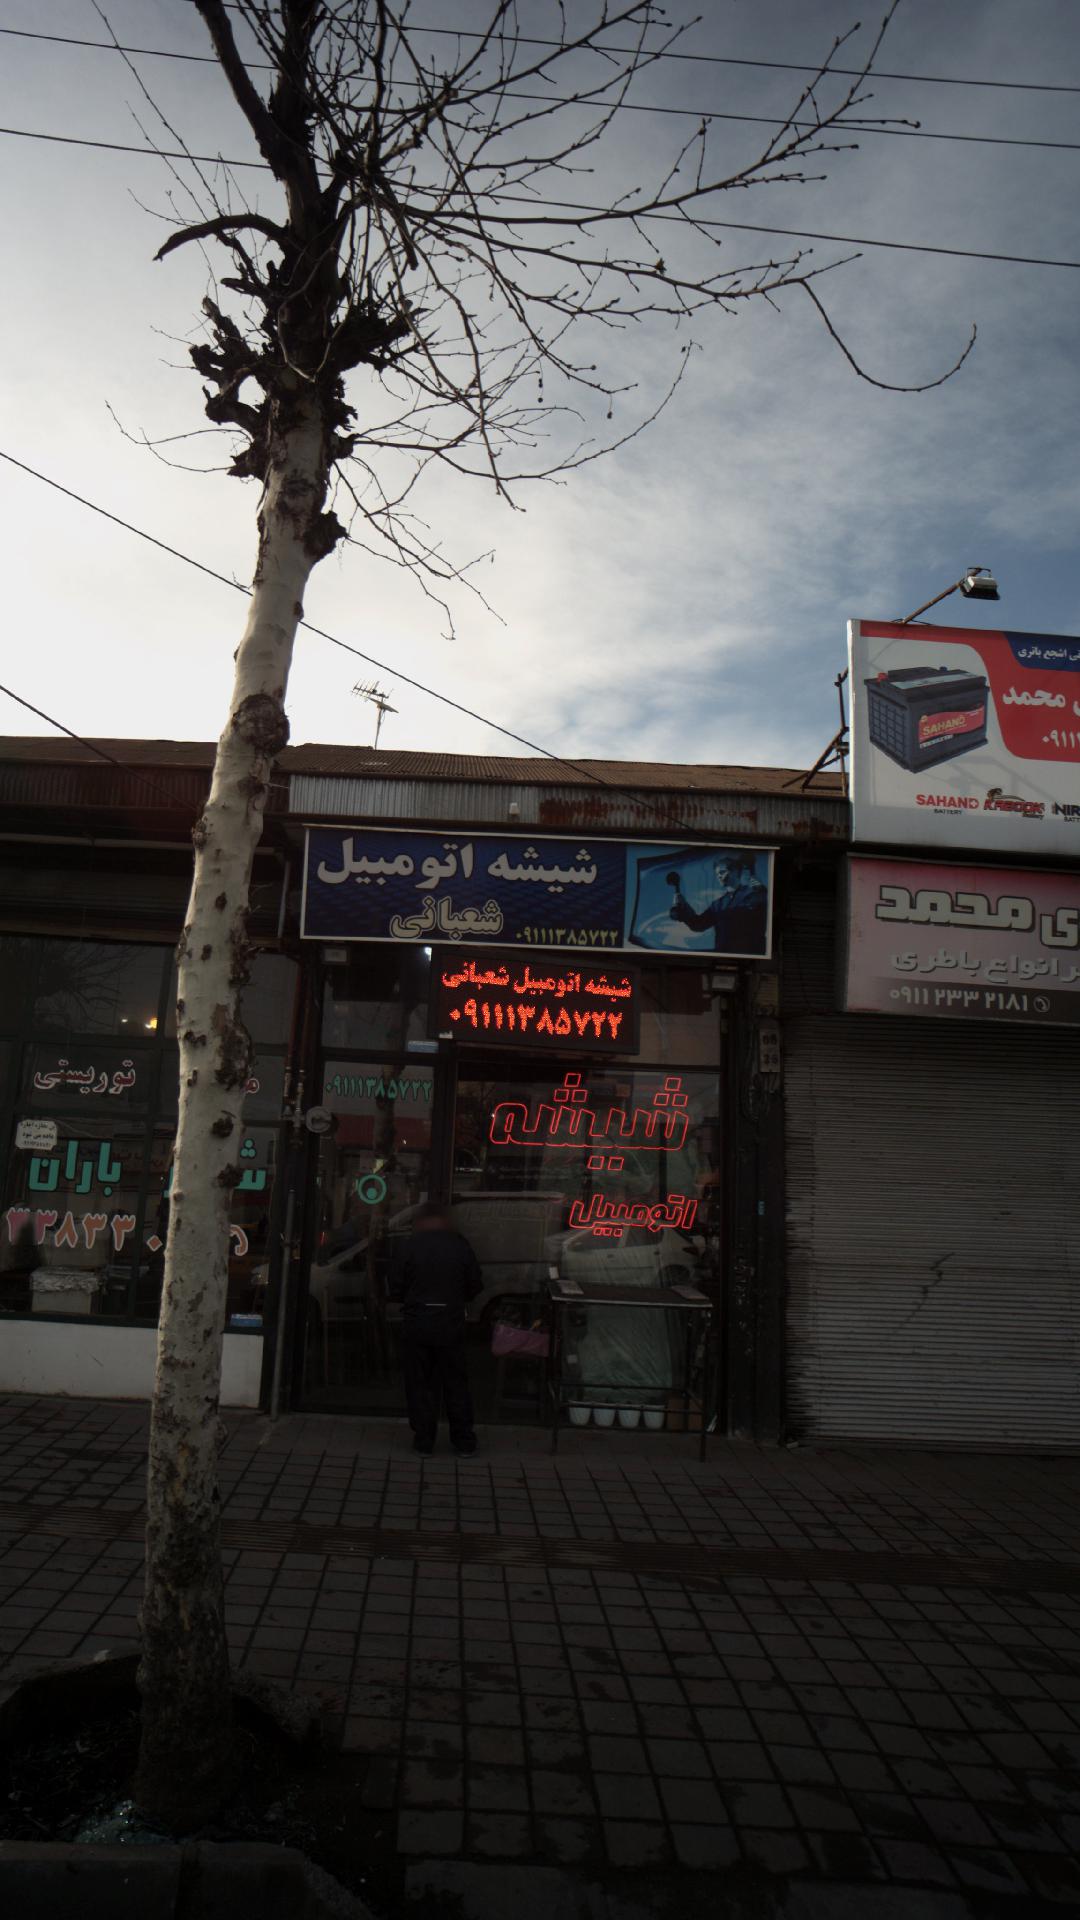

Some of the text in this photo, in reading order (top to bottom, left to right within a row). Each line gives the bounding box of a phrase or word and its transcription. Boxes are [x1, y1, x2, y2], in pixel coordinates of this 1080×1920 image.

[1002, 686, 1066, 709] محمد
[922, 714, 967, 737] SAHAND
[915, 793, 980, 810] SAHAND
[933, 808, 963, 816] BATTERY
[316, 836, 598, 894] شیشه اتومبیل
[389, 895, 504, 941] شعبانی
[875, 885, 1036, 932] محمد
[890, 946, 982, 977] باطری
[983, 953, 1060, 985] انواع
[440, 960, 633, 1003] شیشه اتومبیل شعبانی
[889, 986, 929, 1005] ۰۹۱۱
[33, 1058, 137, 1095] توریستی
[489, 1072, 690, 1172] شیشه
[27, 1138, 123, 1197] باران
[568, 1193, 698, 1238] اتومبیل
